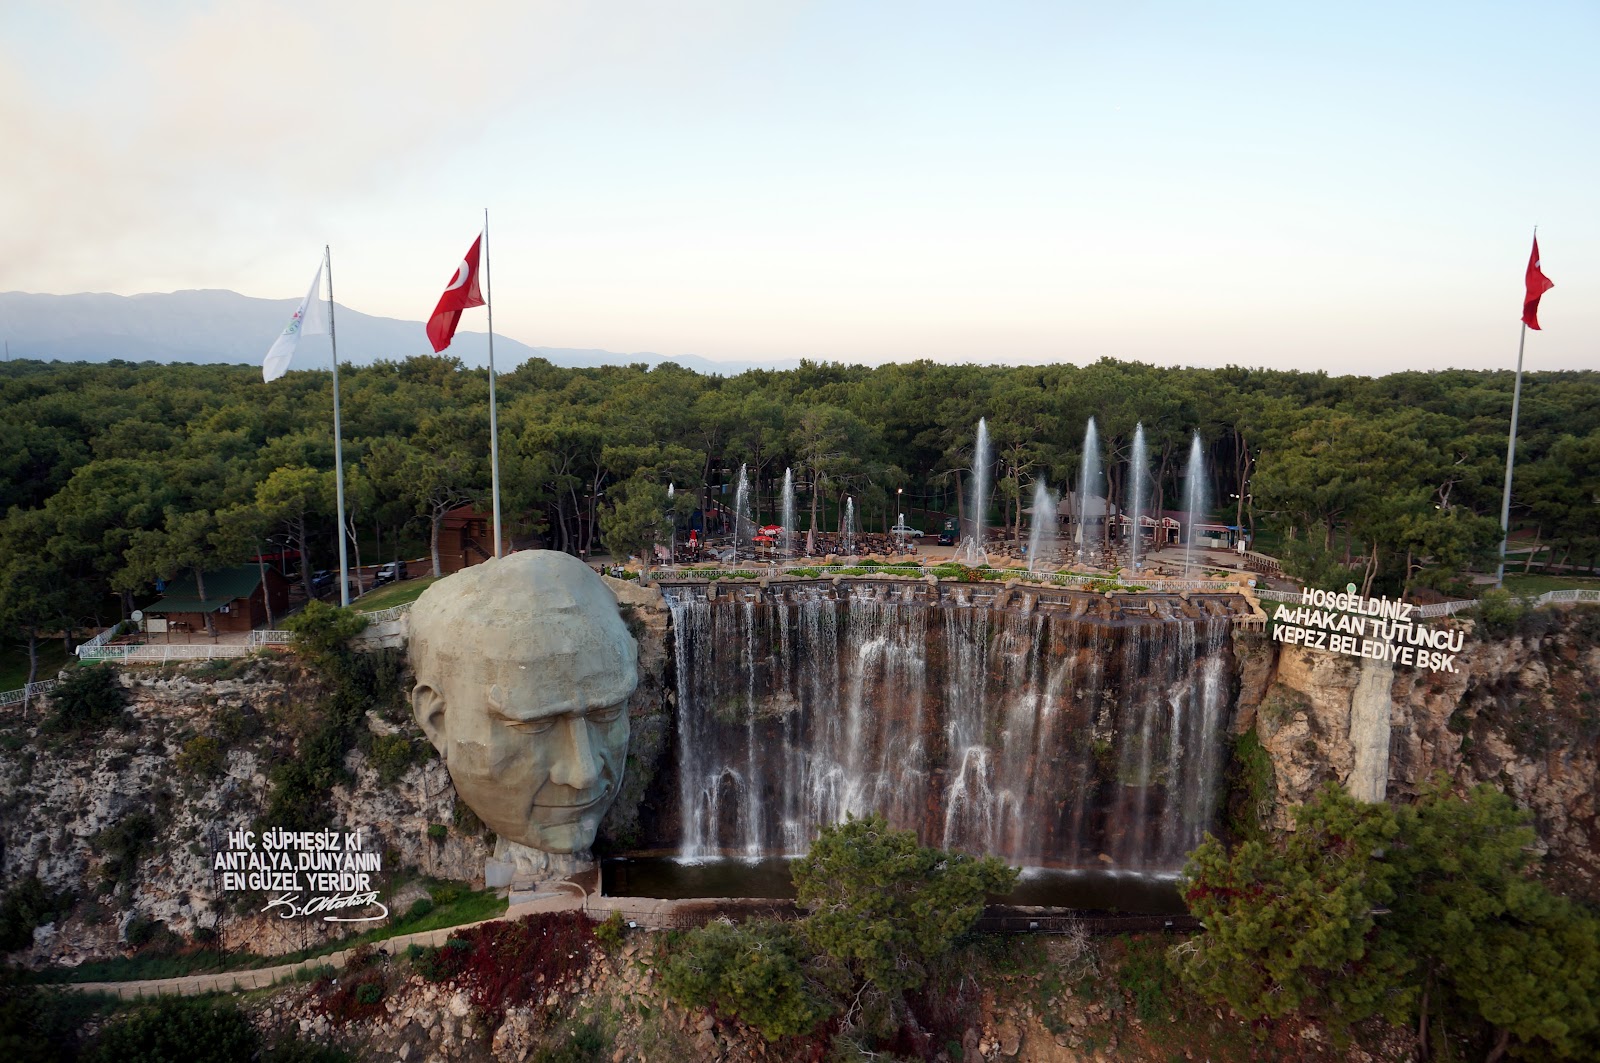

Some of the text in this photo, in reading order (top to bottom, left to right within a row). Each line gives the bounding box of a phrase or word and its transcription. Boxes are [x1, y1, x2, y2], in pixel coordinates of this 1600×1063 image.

[1302, 587, 1413, 622] HOŞGELDİNİZ
[1272, 624, 1326, 649] KEPEZ
[1329, 634, 1413, 666] BELEDİYE
[1370, 619, 1464, 653] TÜTÜNCÜ
[228, 826, 362, 853] HİÇ ŞÜPHESİZ Kİ
[223, 870, 371, 891] EN GÜZEL YERİDİR
